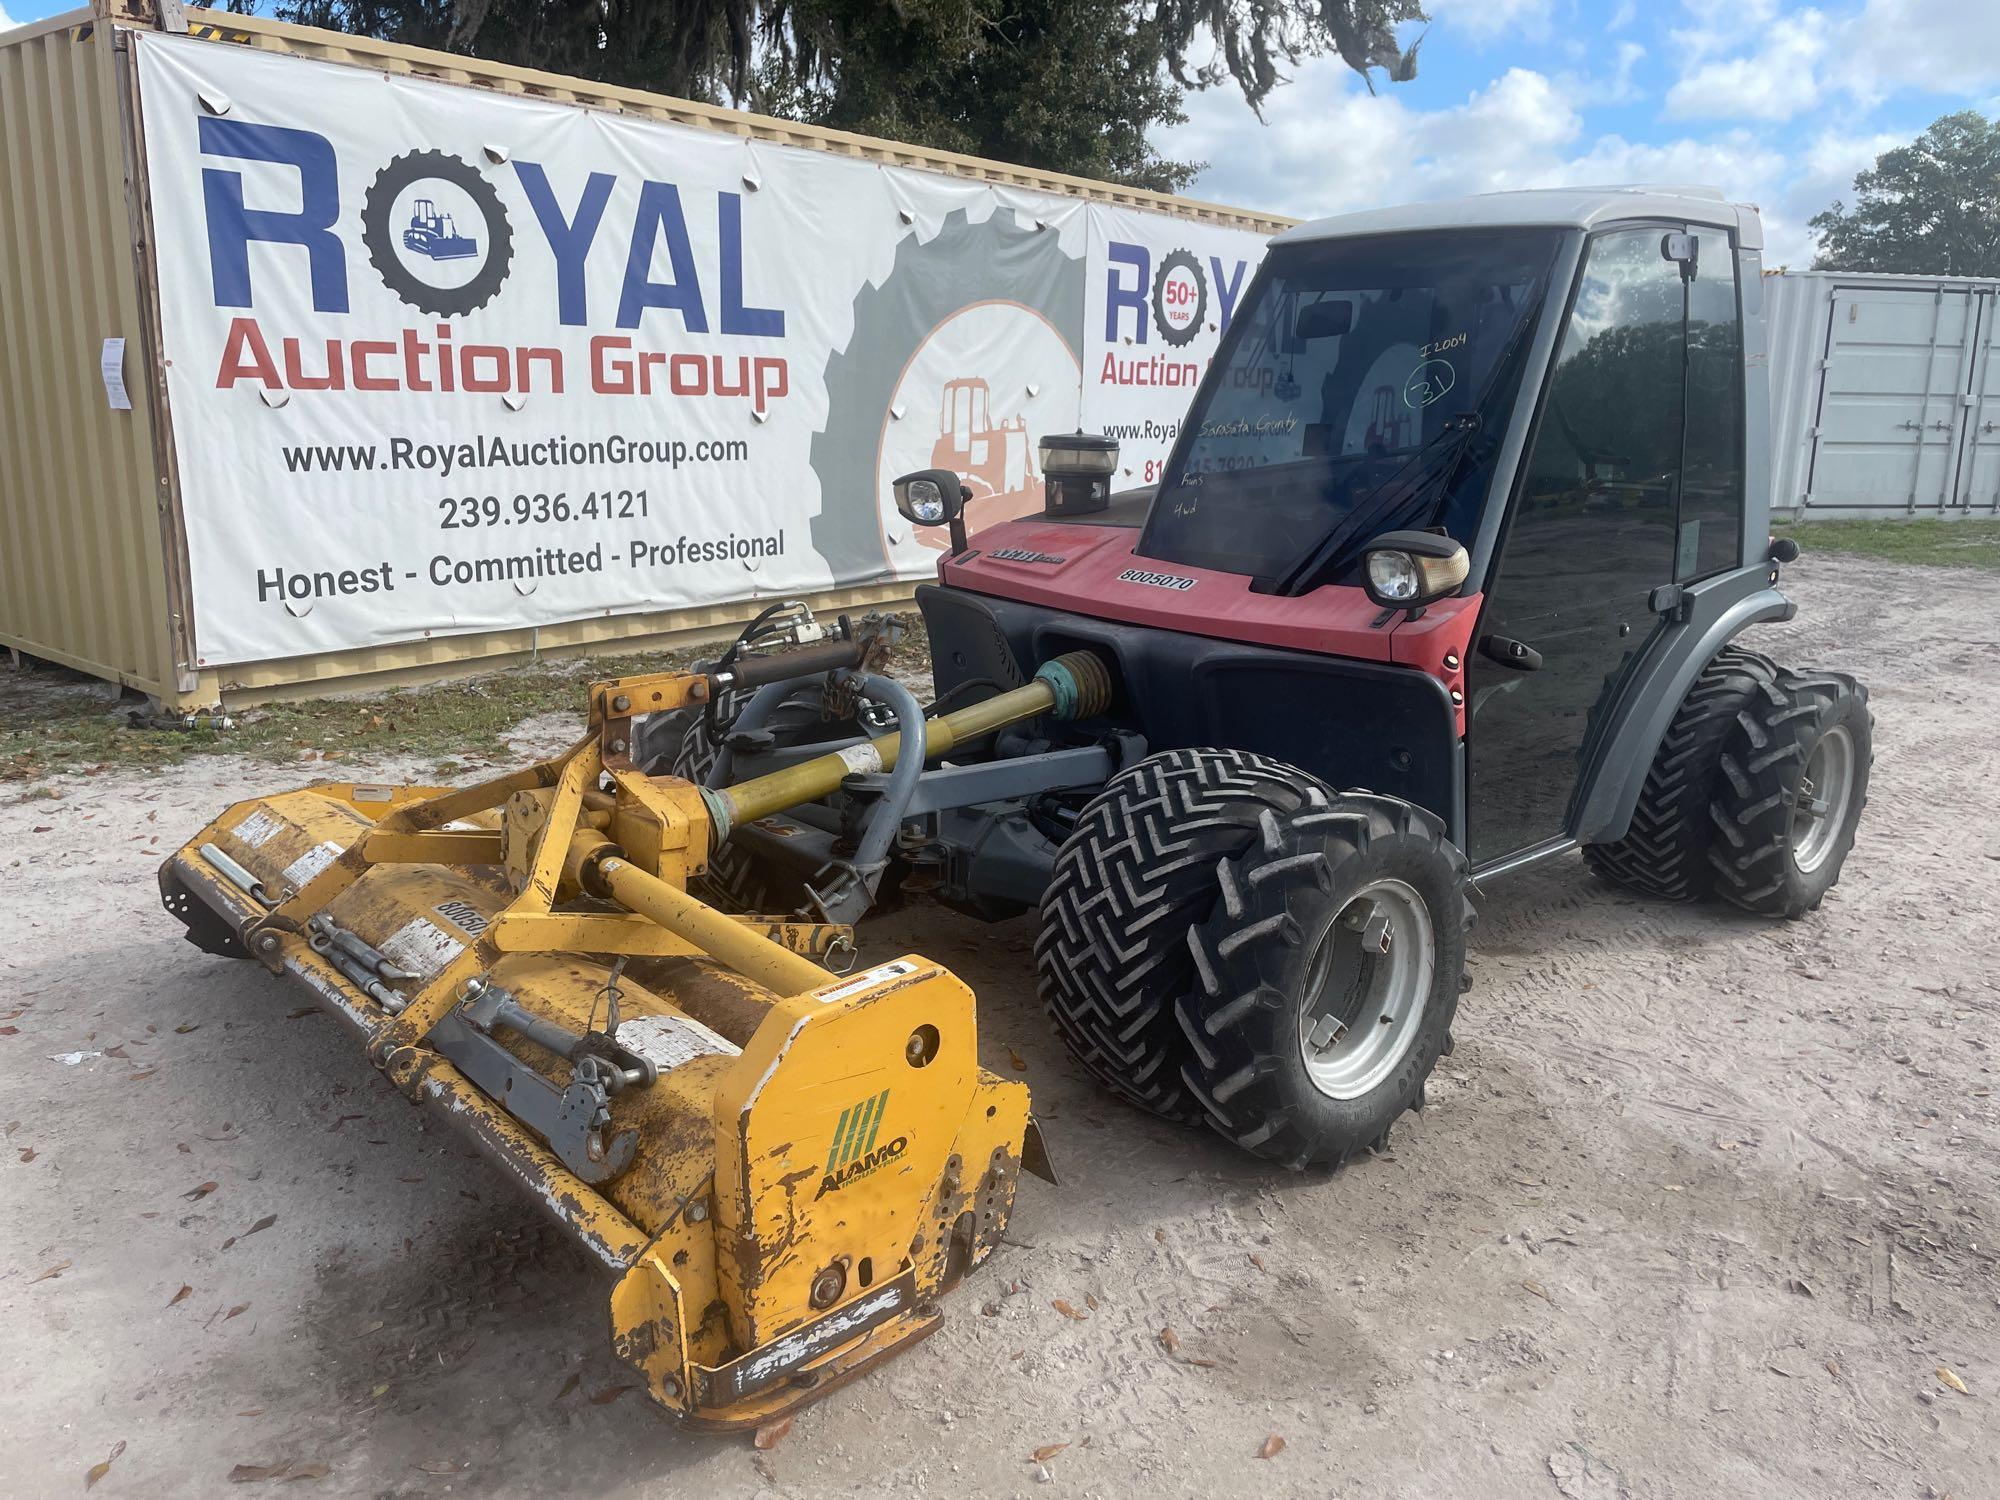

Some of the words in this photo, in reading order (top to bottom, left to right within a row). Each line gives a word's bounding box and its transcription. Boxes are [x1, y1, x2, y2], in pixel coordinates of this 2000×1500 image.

[198, 115, 785, 338] ROYAL
[1166, 281, 1197, 305] 50+
[1169, 311, 1190, 321] YEARS
[215, 317, 563, 395] Auction
[590, 335, 788, 412] Group
[1100, 351, 1198, 386] Auction
[1410, 375, 1446, 404] 31
[282, 434, 748, 474] www.RoyalAuctionGroup.com
[438, 490, 650, 530] 239.936.4121
[257, 560, 395, 602] Honest
[429, 543, 603, 587] Committed
[629, 530, 785, 570] Professional
[1120, 569, 1194, 589] 8005070
[813, 1136, 908, 1202] ALAMO
[841, 1150, 908, 1189] INDUSTRIAL
